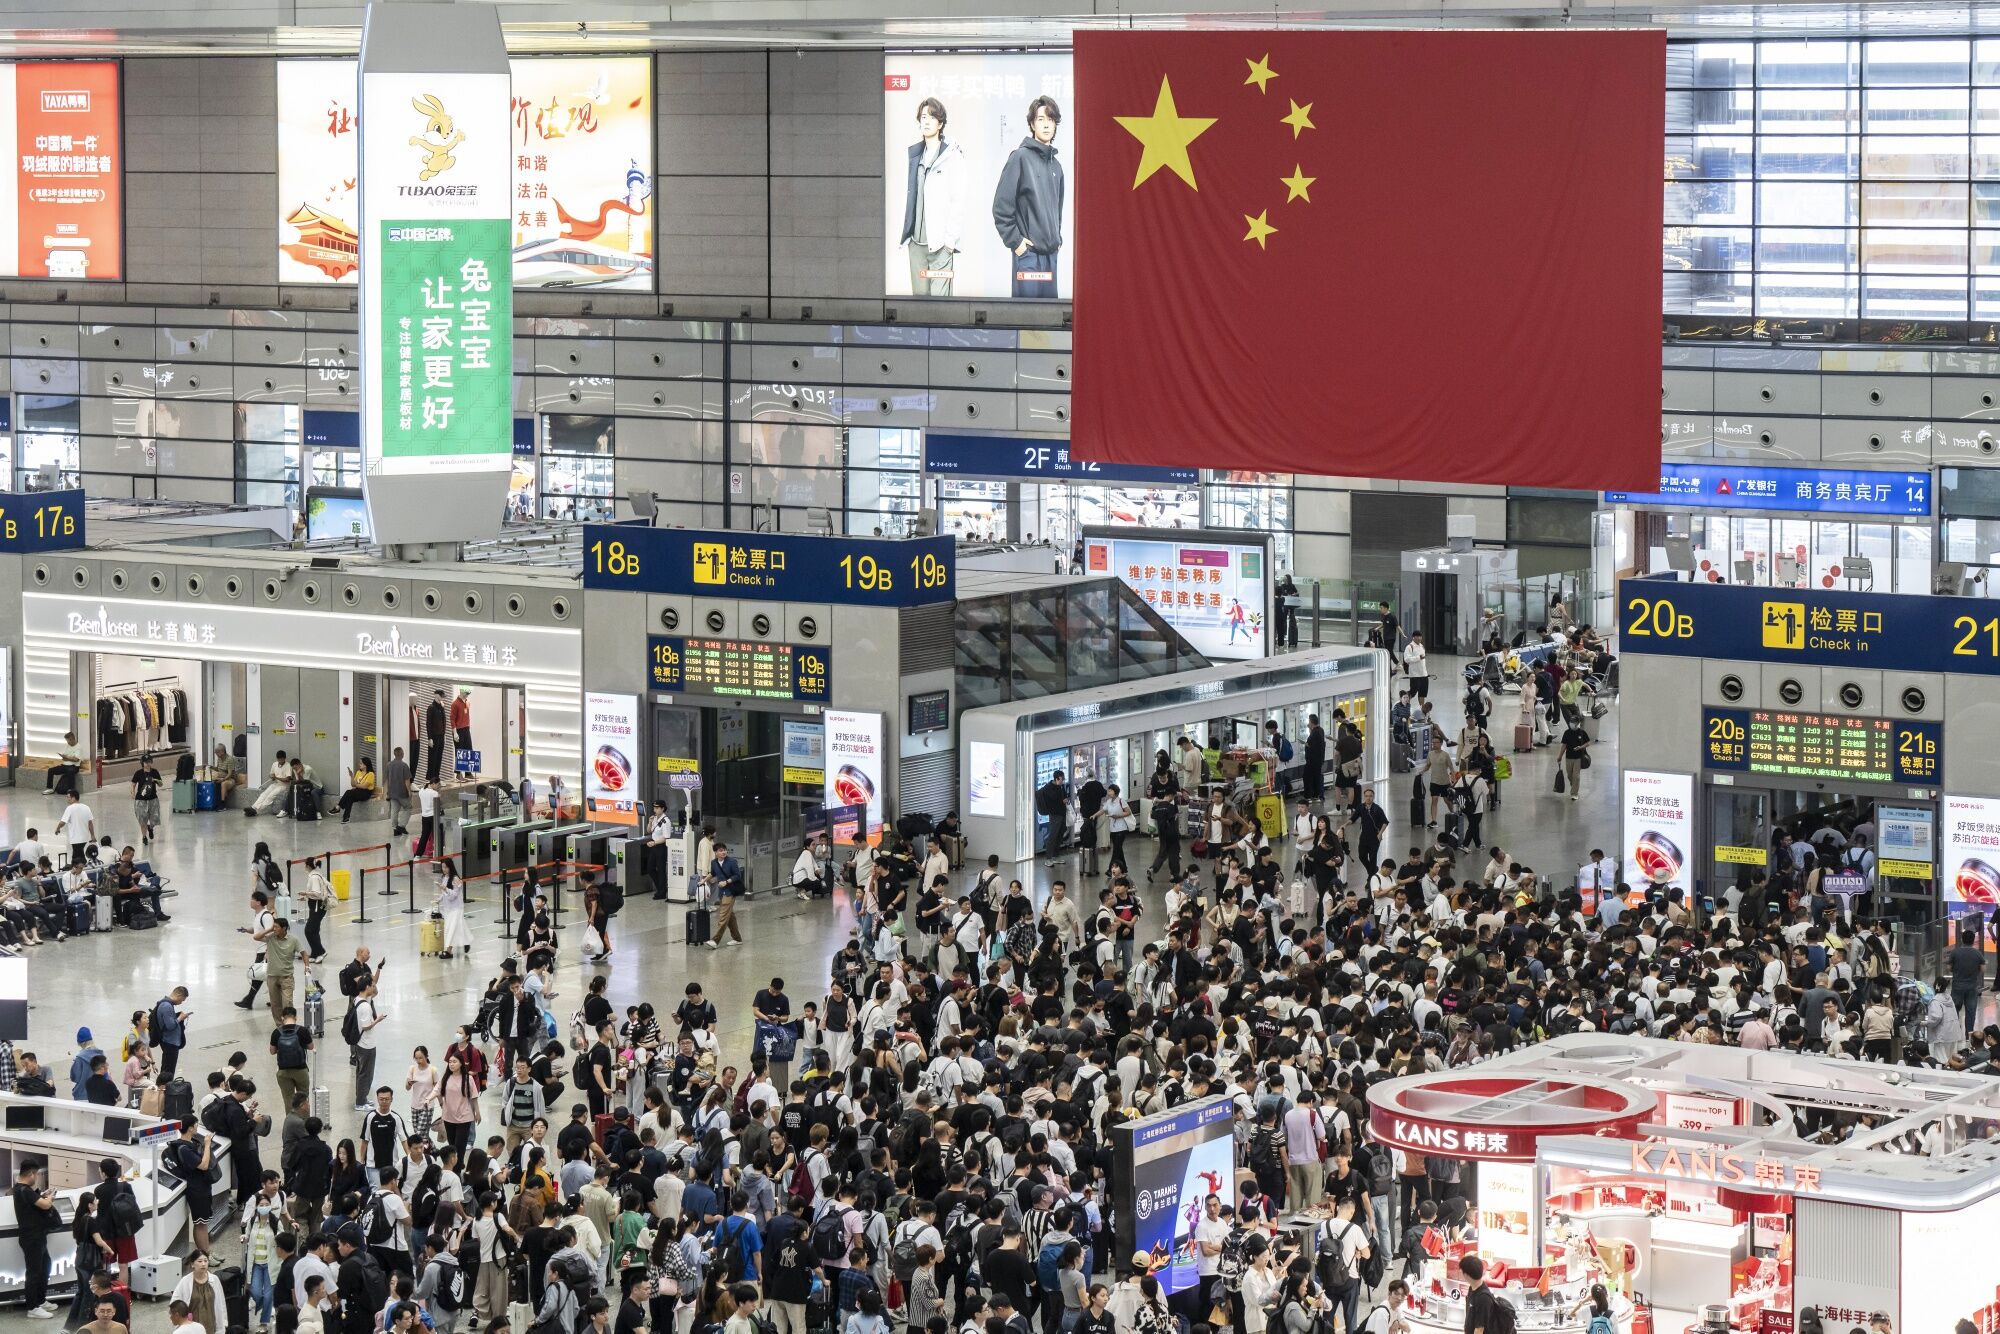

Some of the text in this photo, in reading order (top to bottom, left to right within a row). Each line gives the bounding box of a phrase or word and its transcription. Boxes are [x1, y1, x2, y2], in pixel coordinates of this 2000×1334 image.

[36, 135, 98, 152] 中国第一件
[22, 155, 112, 173] 羽绒服的制造者
[517, 155, 548, 172] 和谐
[517, 183, 548, 199] 法治
[517, 211, 548, 227] 友善
[460, 257, 491, 369] 兔宝宝
[421, 276, 455, 430] 让家更好
[399, 317, 412, 431] 专注健康家居板材
[1024, 448, 1050, 469] 2F
[1057, 449, 1069, 463] 南
[1055, 463, 1072, 471] South
[1660, 476, 1701, 487] 中国人寿
[1737, 479, 1777, 492] 广发银行
[1796, 481, 1891, 501] 商务贵宾厅
[1905, 487, 1924, 502] 14
[34, 505, 75, 538] 17B
[591, 541, 640, 576] 18B
[730, 547, 785, 570] 检票口
[840, 554, 893, 591] 19B
[910, 552, 947, 589] 19B
[1128, 565, 1222, 583] 维护站车秩序
[730, 573, 775, 586] Check in
[1131, 588, 1222, 607] 享旅途生活
[1627, 598, 1694, 638] 20B
[1809, 606, 1882, 633] 检票口
[148, 620, 216, 643] 比音勒芬
[1953, 616, 2000, 657] 21
[1809, 636, 1869, 651] Check in
[443, 642, 517, 667] 比音勒芬
[654, 645, 680, 664] 18B
[654, 666, 680, 677] 检票口
[798, 655, 825, 674] 19B
[798, 677, 825, 688] 检票口
[1709, 718, 1745, 740] 20B
[1755, 713, 1769, 721] 车次
[1776, 714, 1798, 723] 终到站
[1805, 716, 1819, 725] 开点
[1824, 717, 1839, 726] 站台
[1846, 719, 1863, 728] 状态
[835, 733, 871, 743] 好饭煲就选
[1899, 731, 1936, 754] 21B
[832, 743, 874, 754] 苏泊尔旋焰釜
[1710, 742, 1744, 755] 检票口
[1803, 746, 1821, 754] 12:12
[1900, 756, 1935, 768] 检票口
[1636, 795, 1680, 808] 好饭煲就选
[1631, 807, 1684, 820] 苏泊尔旋焰釜
[1709, 1107, 1722, 1115] TOP
[1394, 1119, 1508, 1153] KANS 韩束
[1631, 1143, 1822, 1192] KANS 韩束
[1154, 1184, 1178, 1200] TARANIS
[1768, 1315, 1792, 1327] SALE
